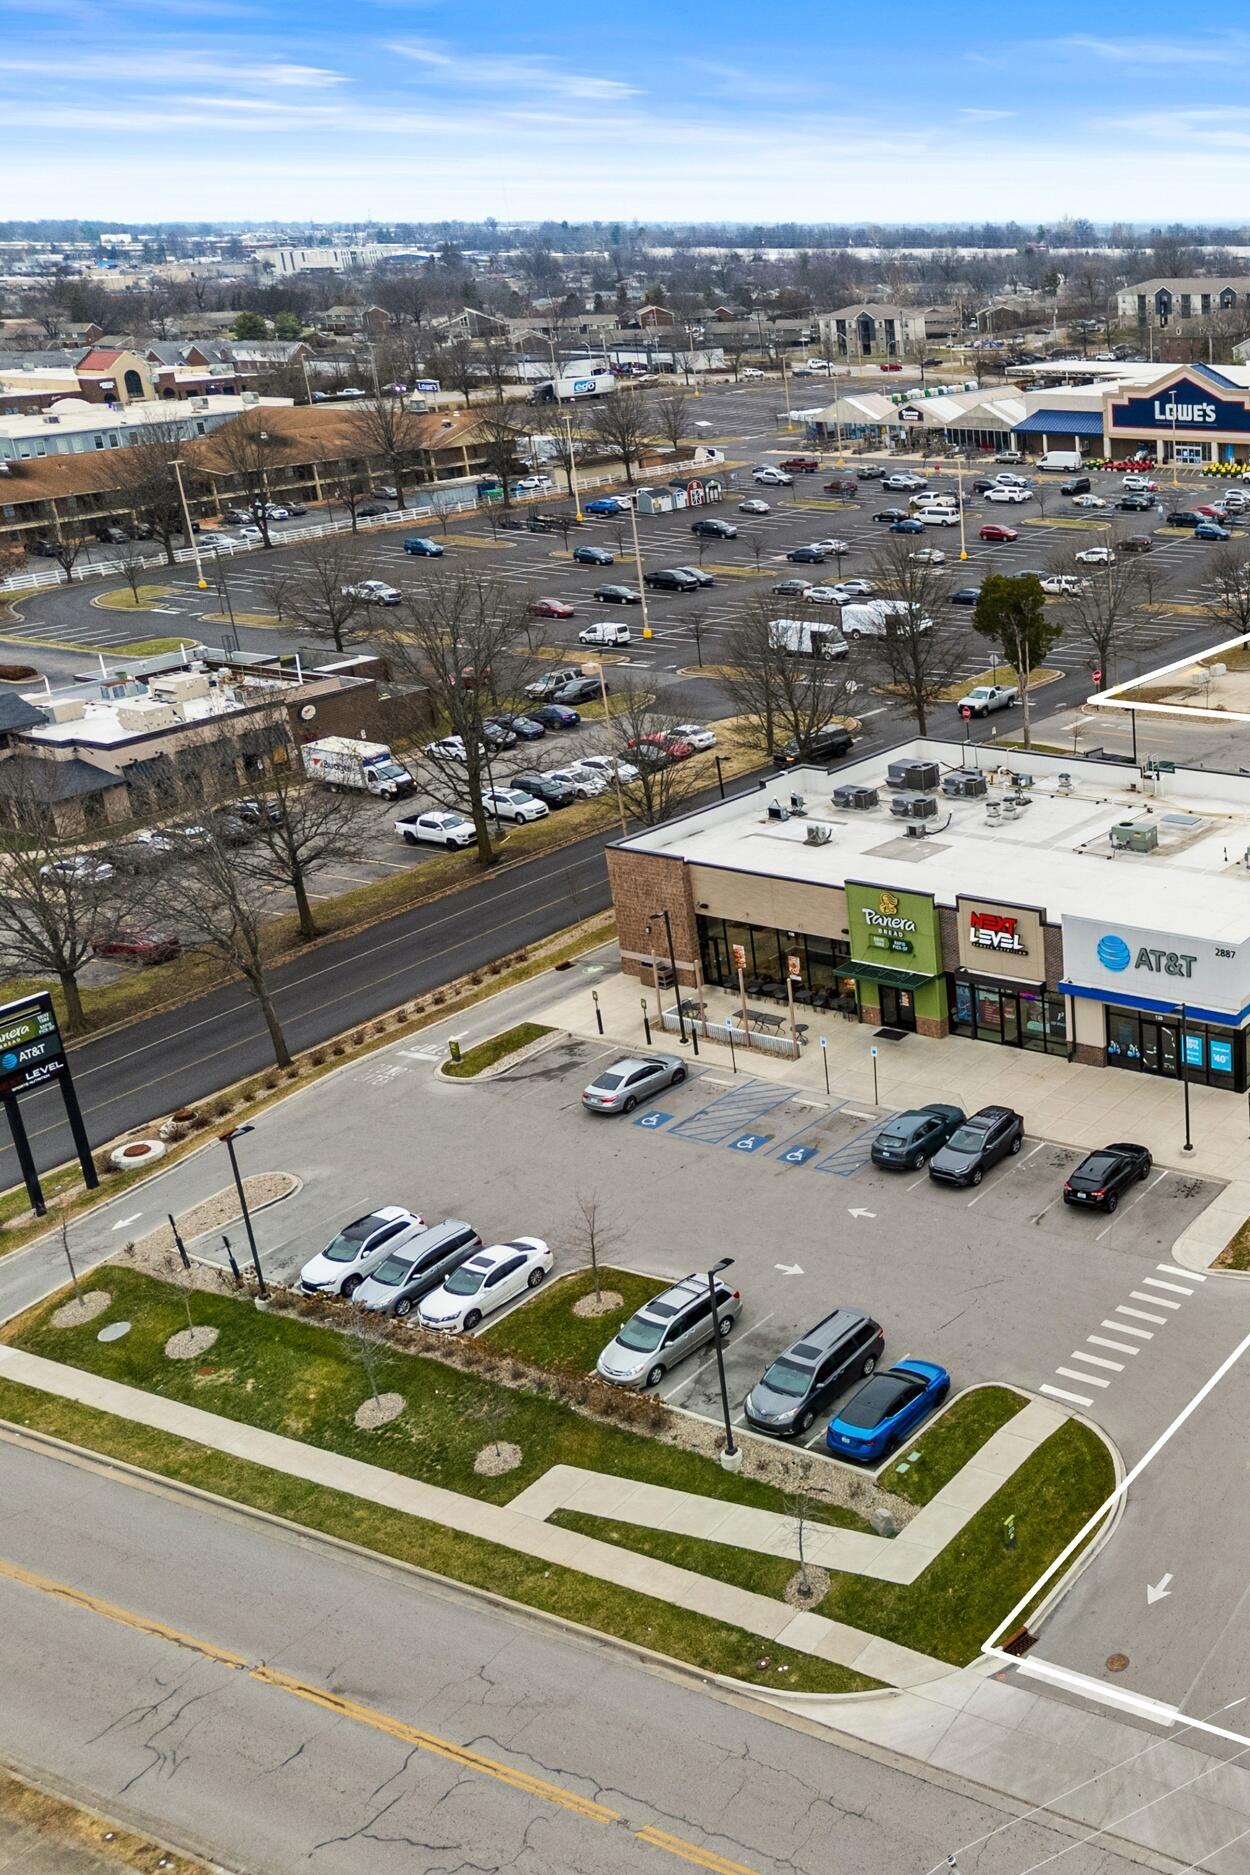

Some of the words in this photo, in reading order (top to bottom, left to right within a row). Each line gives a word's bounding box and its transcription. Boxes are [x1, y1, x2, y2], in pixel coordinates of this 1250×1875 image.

[1154, 400, 1216, 422] LOWE'S
[862, 907, 916, 932] Panera
[970, 911, 1018, 937] NEXT
[970, 927, 1024, 949] LEVEL
[1134, 947, 1197, 978] AT&T
[1215, 948, 1236, 959] 2887
[19, 1043, 46, 1062] AT&T
[25, 1061, 64, 1080] LEVEL
